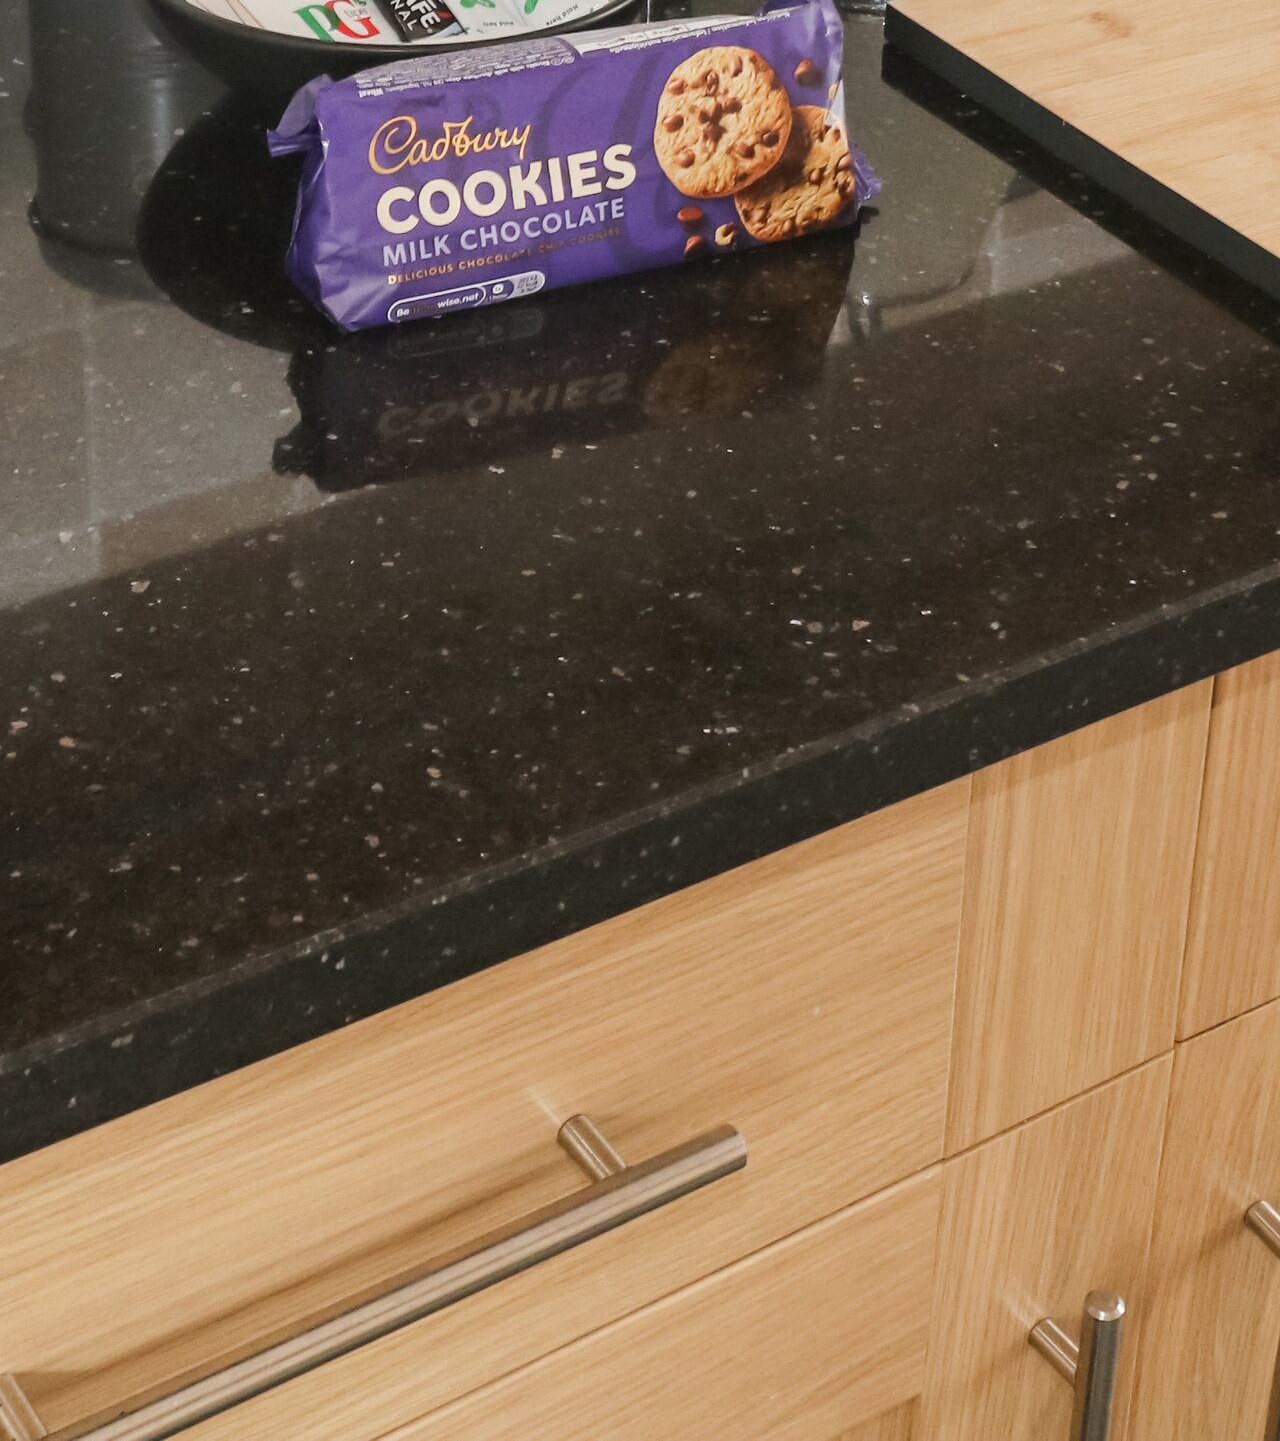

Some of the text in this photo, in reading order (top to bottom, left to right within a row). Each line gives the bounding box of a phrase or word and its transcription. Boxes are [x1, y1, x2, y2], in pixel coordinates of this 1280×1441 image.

[368, 115, 532, 175] Cadbury
[376, 144, 637, 234] COOKIES
[383, 200, 625, 267] MILK CHOCOLATE
[388, 263, 454, 285] DELICIOUS
[458, 249, 533, 271] CHOCOLATE
[396, 308, 410, 318] Be
